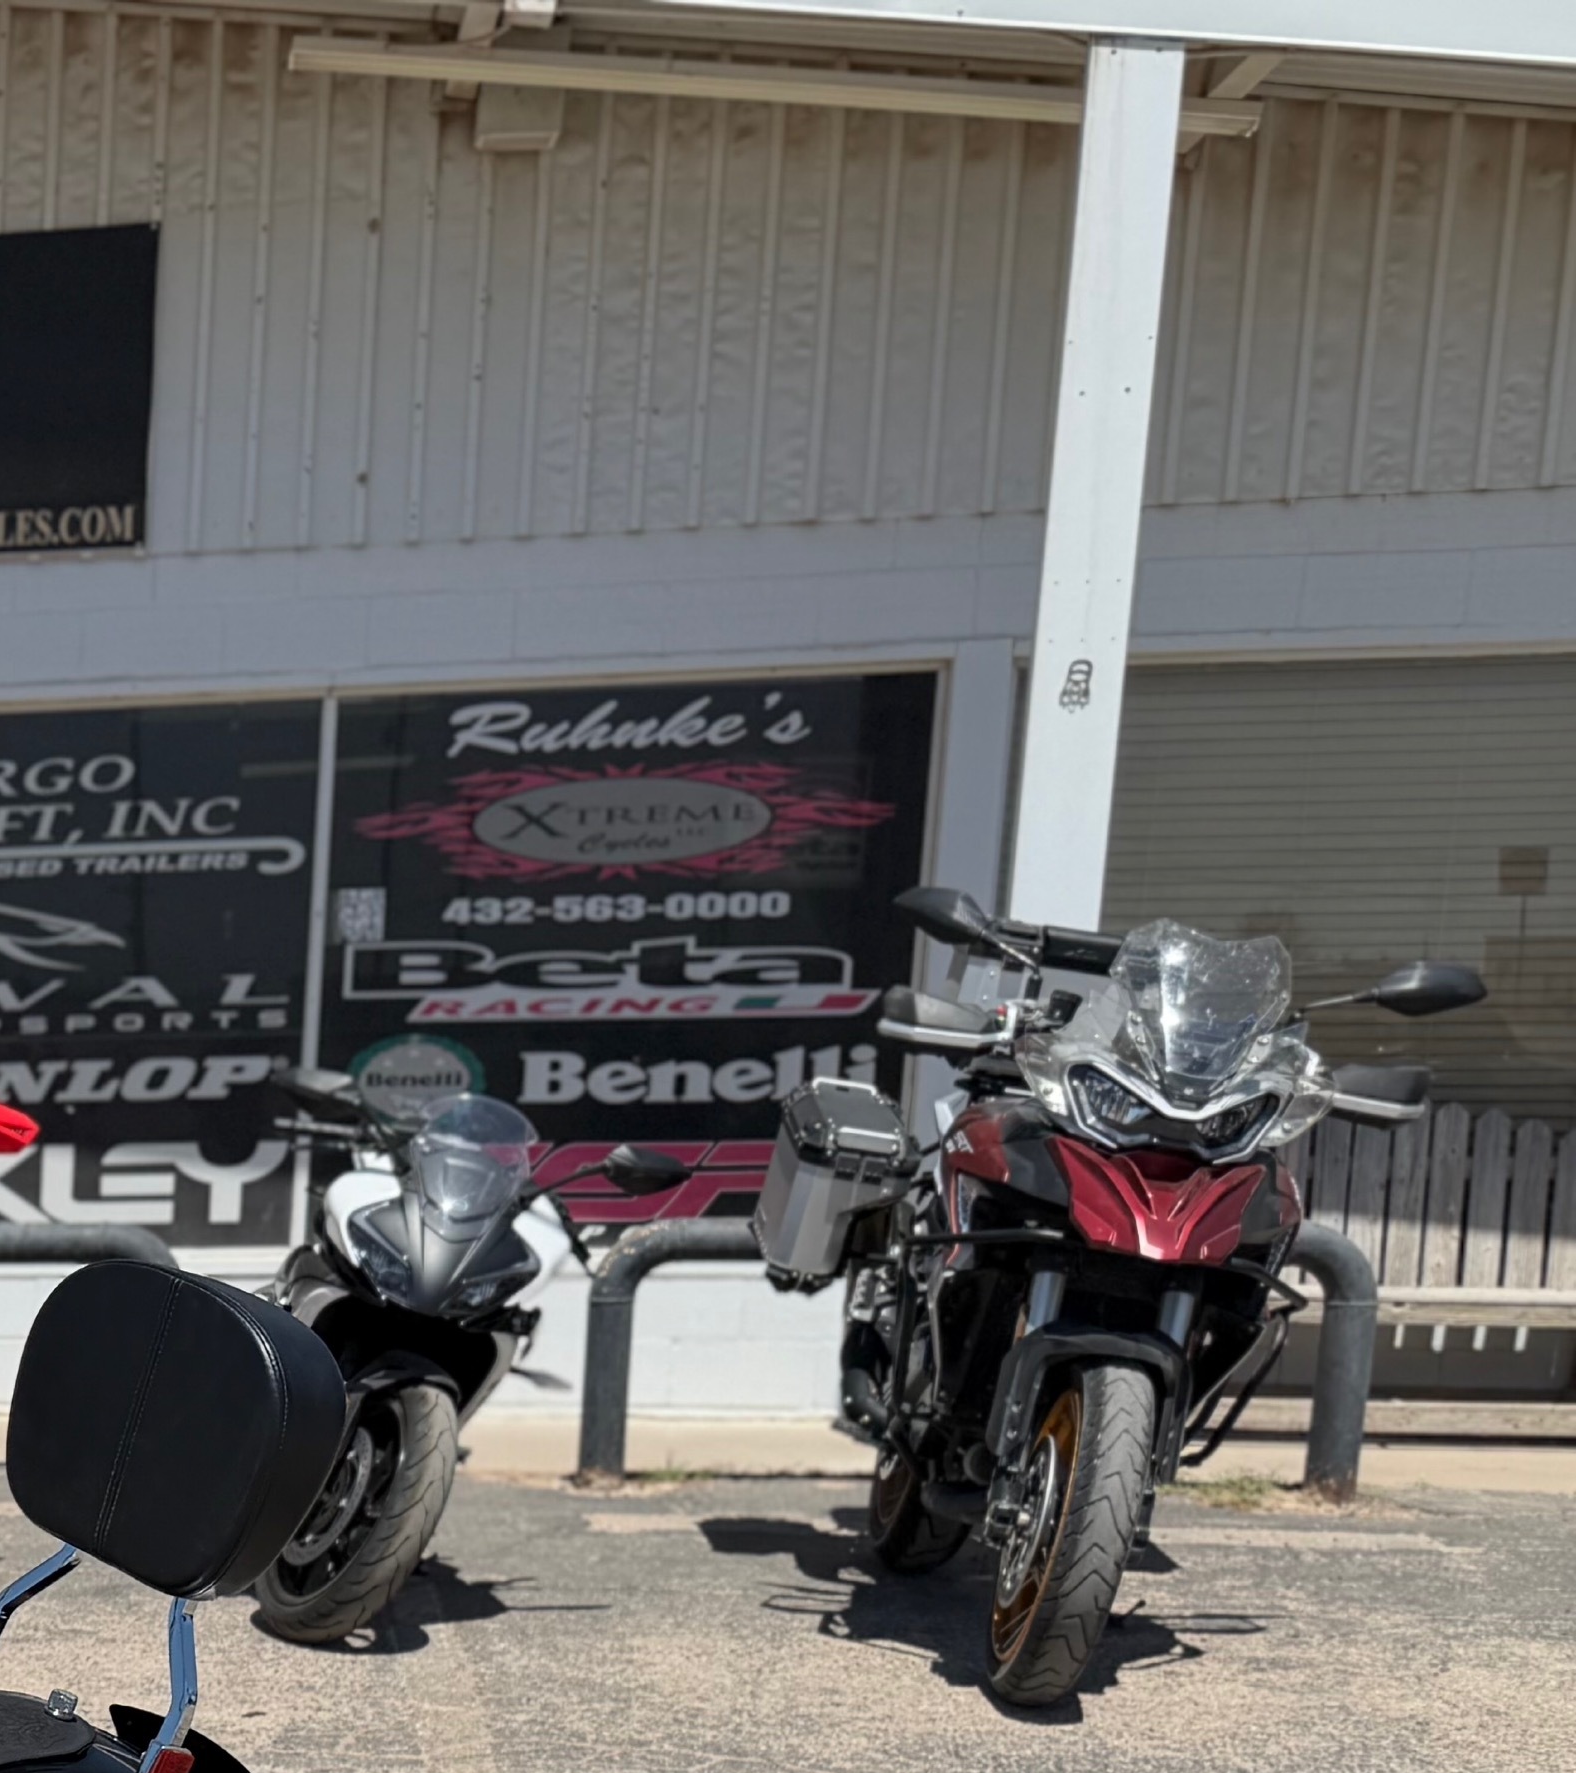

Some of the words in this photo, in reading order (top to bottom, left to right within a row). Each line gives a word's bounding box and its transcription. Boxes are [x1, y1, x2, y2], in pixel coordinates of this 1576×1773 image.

[446, 691, 812, 758] Ruhnke's
[103, 797, 241, 841] INC
[500, 801, 758, 841] XTREME
[73, 851, 249, 877] TRAILERS
[442, 891, 791, 926] 432-563-0000
[419, 995, 721, 1018] RACING
[366, 1071, 463, 1088] Benelli
[517, 1043, 879, 1105] Benelli
